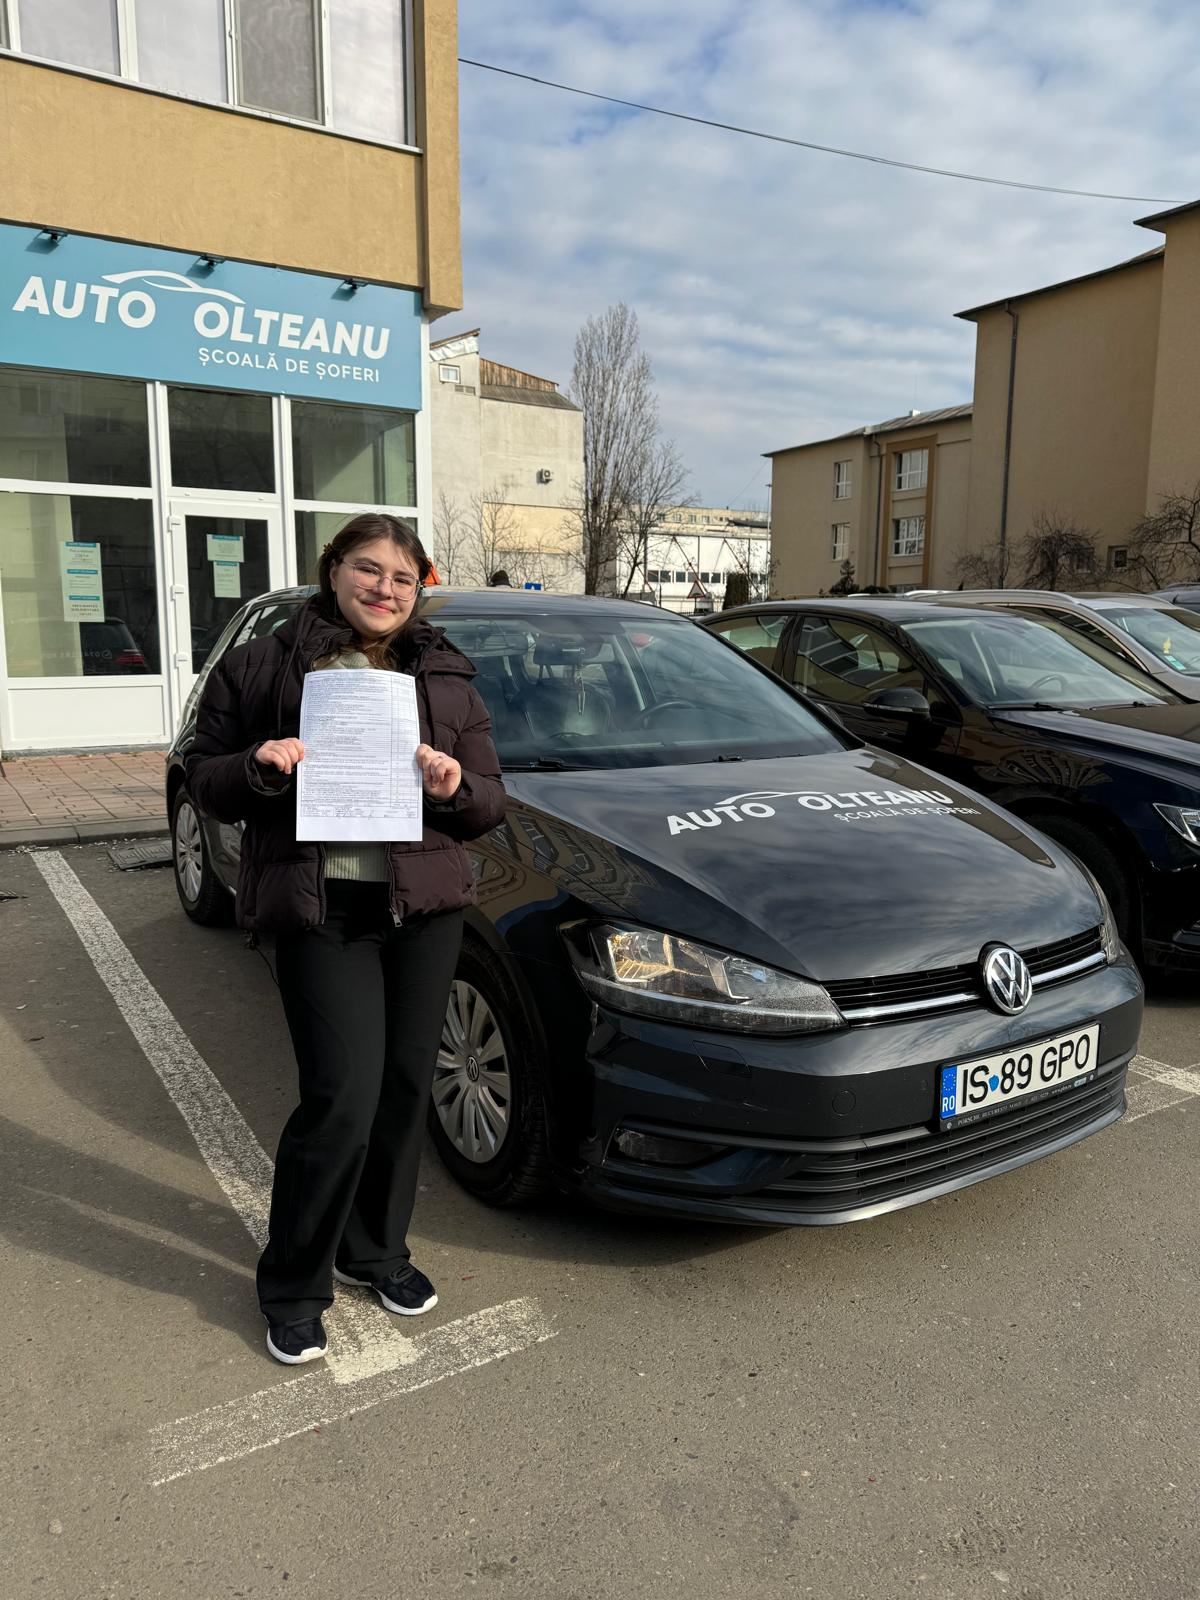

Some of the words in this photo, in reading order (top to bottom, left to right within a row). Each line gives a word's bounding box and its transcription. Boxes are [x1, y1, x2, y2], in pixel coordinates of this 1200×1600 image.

[12, 275, 156, 329] AUTO
[193, 301, 390, 360] OLTEANU
[198, 347, 277, 371] ȘCOALĂ
[285, 358, 309, 375] DE
[315, 362, 380, 383] ȘOFERI
[666, 802, 776, 836] AUTO
[797, 790, 954, 811] OLTEANU
[904, 807, 929, 816] DE
[961, 1065, 990, 1108] IS
[1000, 1053, 1033, 1095] 89
[1040, 1033, 1091, 1082] GPO
[942, 1096, 956, 1113] RO
